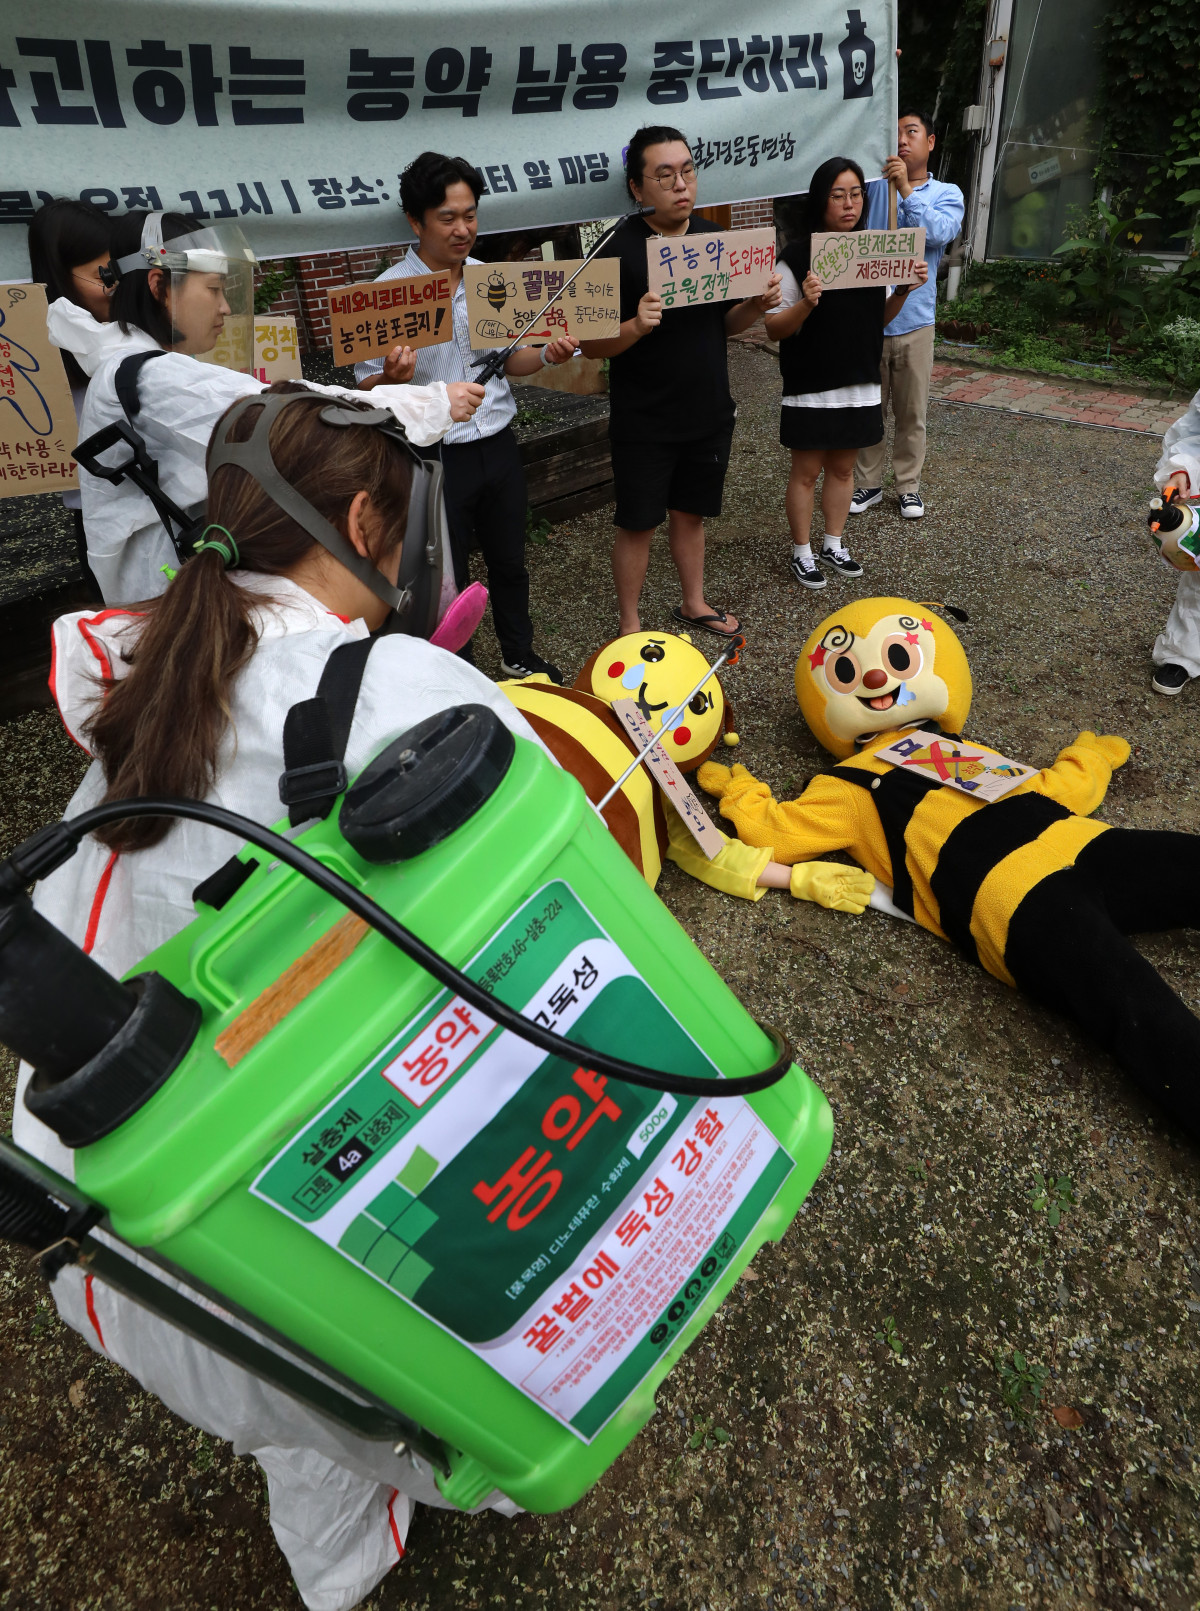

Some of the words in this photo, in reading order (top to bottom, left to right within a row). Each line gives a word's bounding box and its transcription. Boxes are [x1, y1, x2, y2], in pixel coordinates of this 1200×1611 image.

[0, 37, 306, 128] 괴하는
[347, 46, 492, 121] 농약
[512, 43, 627, 114] 남용
[646, 33, 828, 105] 중단하라
[691, 132, 797, 170] 환경운동연합
[179, 182, 273, 219] 11시
[308, 176, 390, 209] 장소:
[523, 160, 550, 190] 앞
[558, 152, 610, 184] 마당
[728, 243, 776, 278] 도입하라
[816, 241, 849, 279] 친환경
[858, 232, 916, 256] 방제조례
[856, 259, 914, 280] 제정하라!
[331, 278, 451, 314] 네오니코티노이드
[584, 282, 614, 297] 죽이는
[543, 307, 567, 330] 남용
[574, 305, 620, 324] 중단하라
[255, 325, 299, 362] 정책
[402, 1006, 479, 1085] 농약
[302, 1107, 362, 1166] 살충제
[639, 1106, 668, 1143] 500g
[303, 1174, 335, 1207] 그룹
[338, 1149, 361, 1170] 4a
[362, 1104, 404, 1146] 살충제
[472, 1066, 622, 1231] 농약
[505, 1253, 550, 1299] [품목명]
[548, 1194, 600, 1254] 디노테퓨란
[601, 1156, 630, 1191] 수화제
[522, 1250, 620, 1354] 꿀벌에
[615, 1177, 674, 1246] 독성
[671, 1108, 724, 1176] 강함
